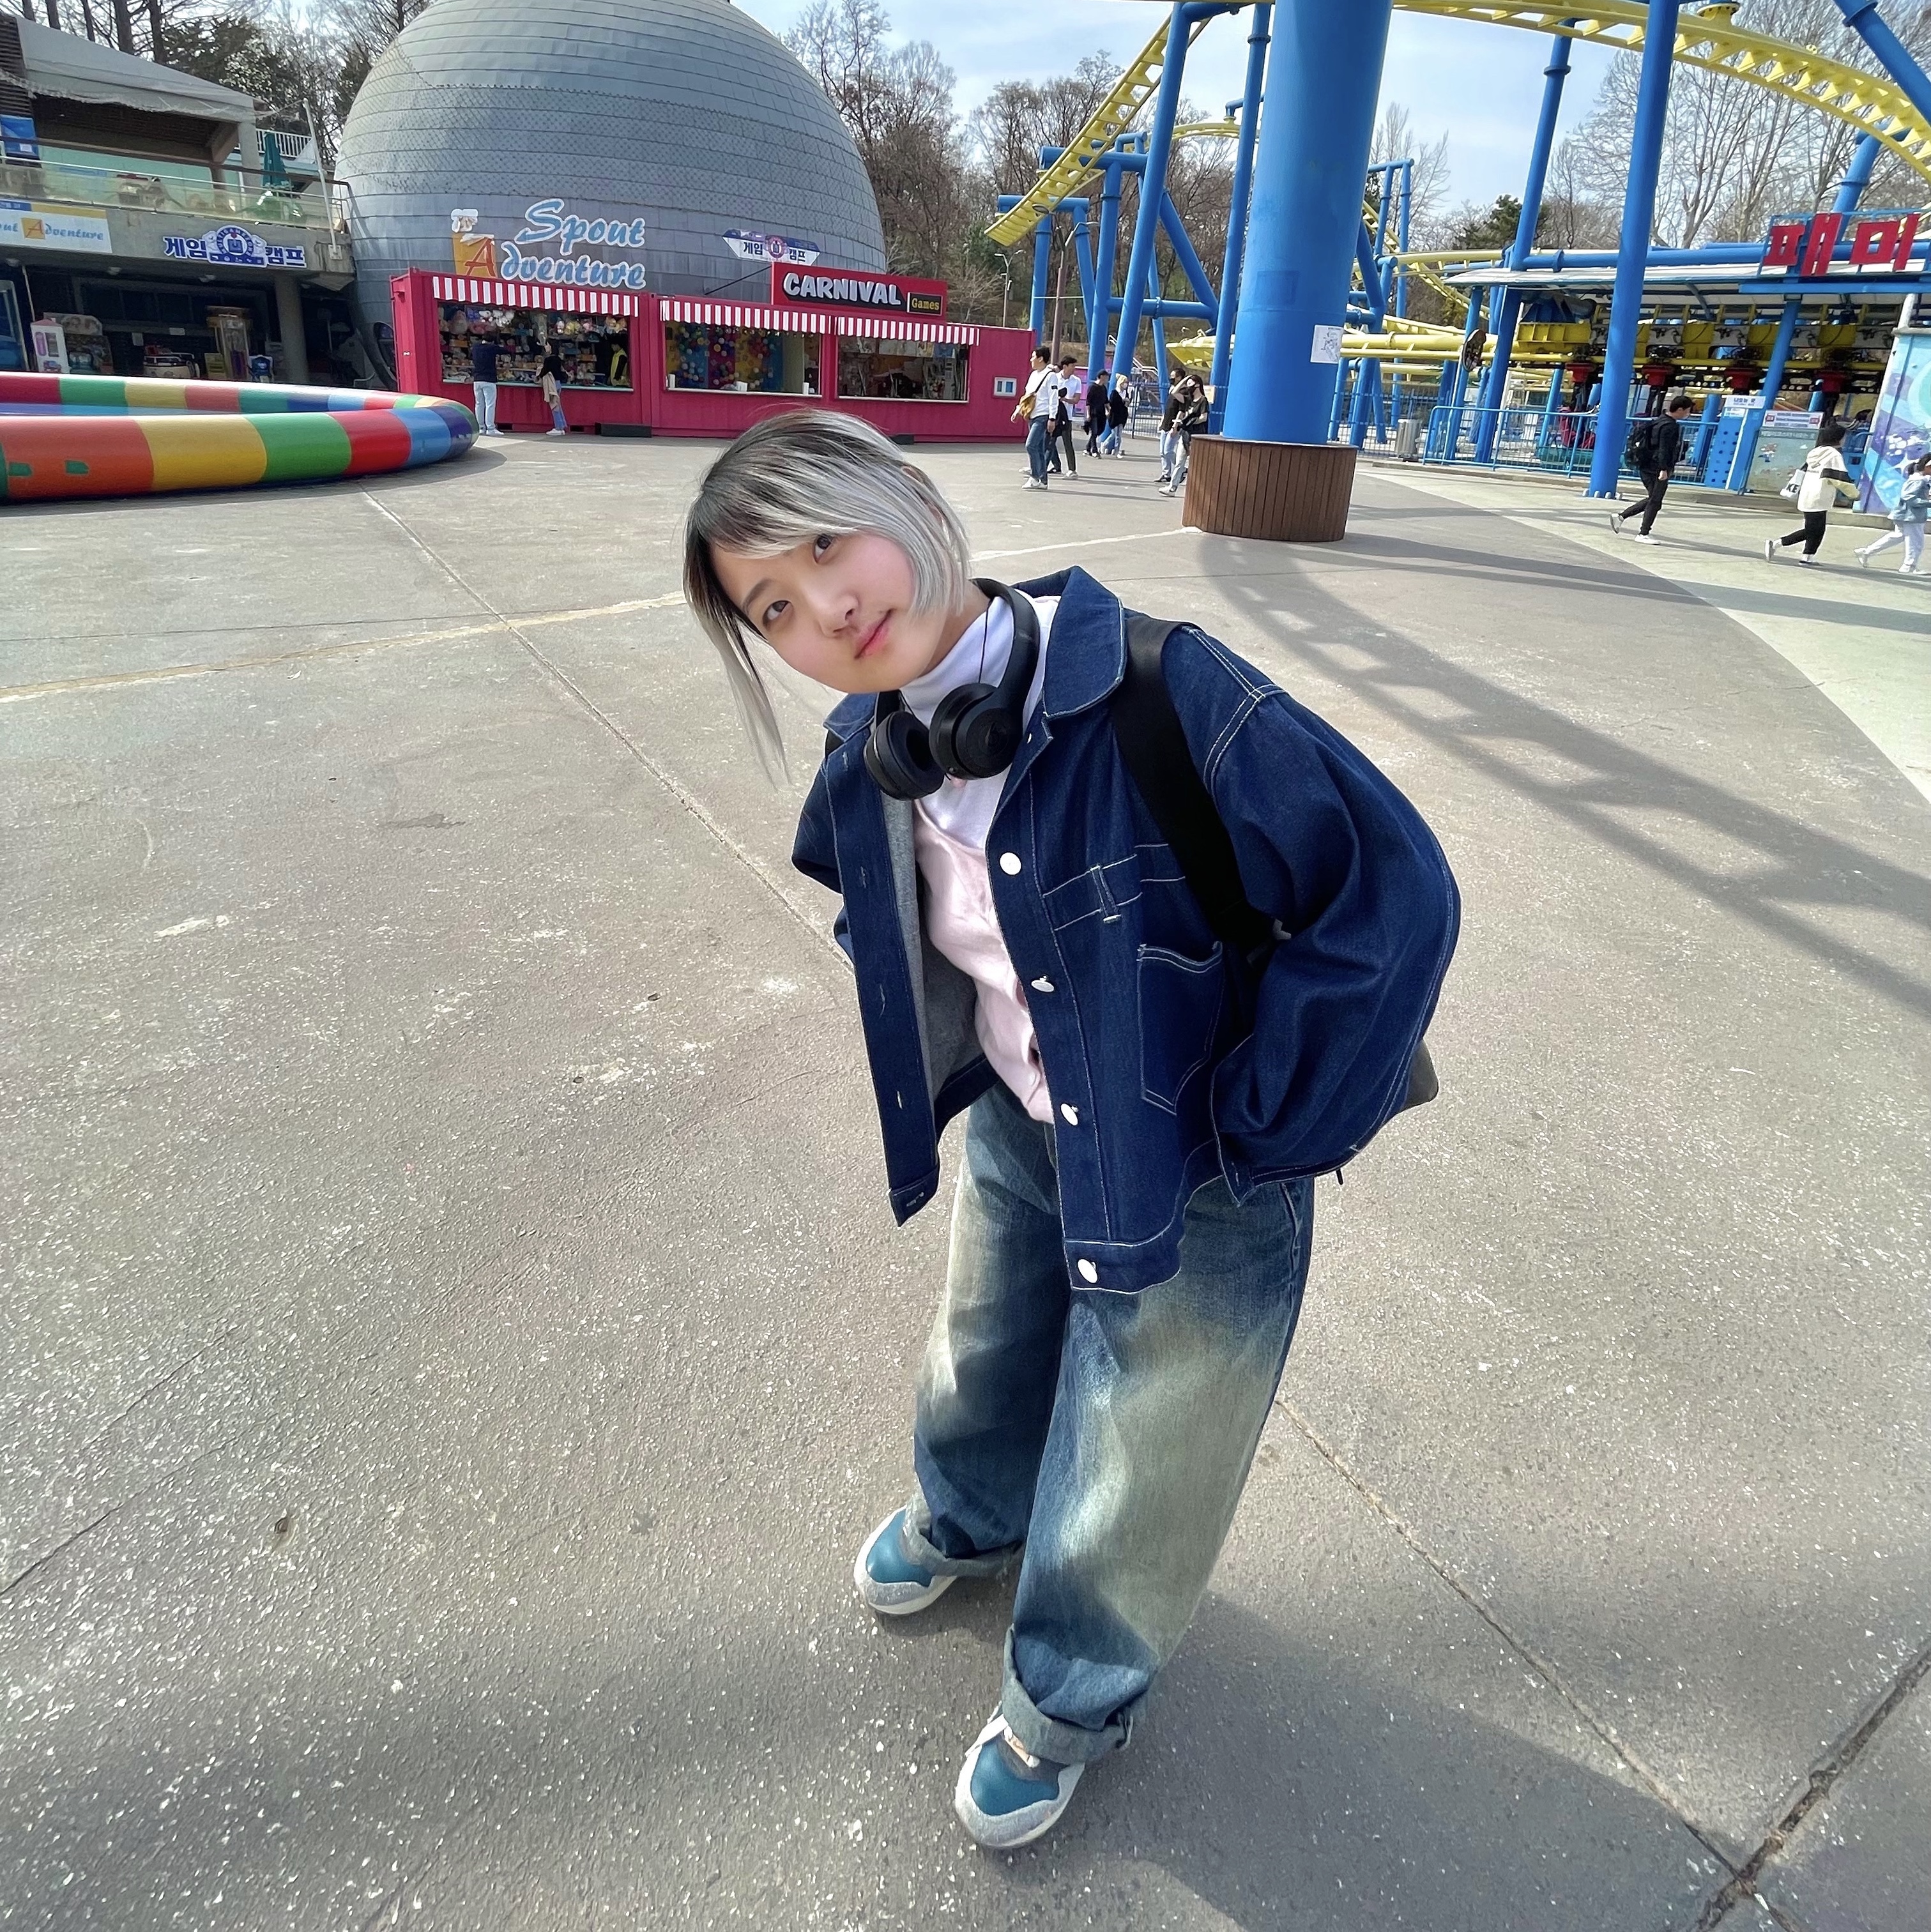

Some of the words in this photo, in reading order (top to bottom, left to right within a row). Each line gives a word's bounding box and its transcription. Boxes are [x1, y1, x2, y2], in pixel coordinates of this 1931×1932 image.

[0, 223, 19, 232] ut
[25, 219, 103, 241] Adventure
[515, 199, 645, 255] Spout
[164, 237, 207, 258] 게임
[265, 247, 305, 266] 캠프
[464, 237, 646, 289] Adventure
[744, 241, 763, 255] 게임
[789, 248, 805, 262] 캠프
[783, 272, 901, 305] CARNIVAL
[912, 298, 940, 310] Games
